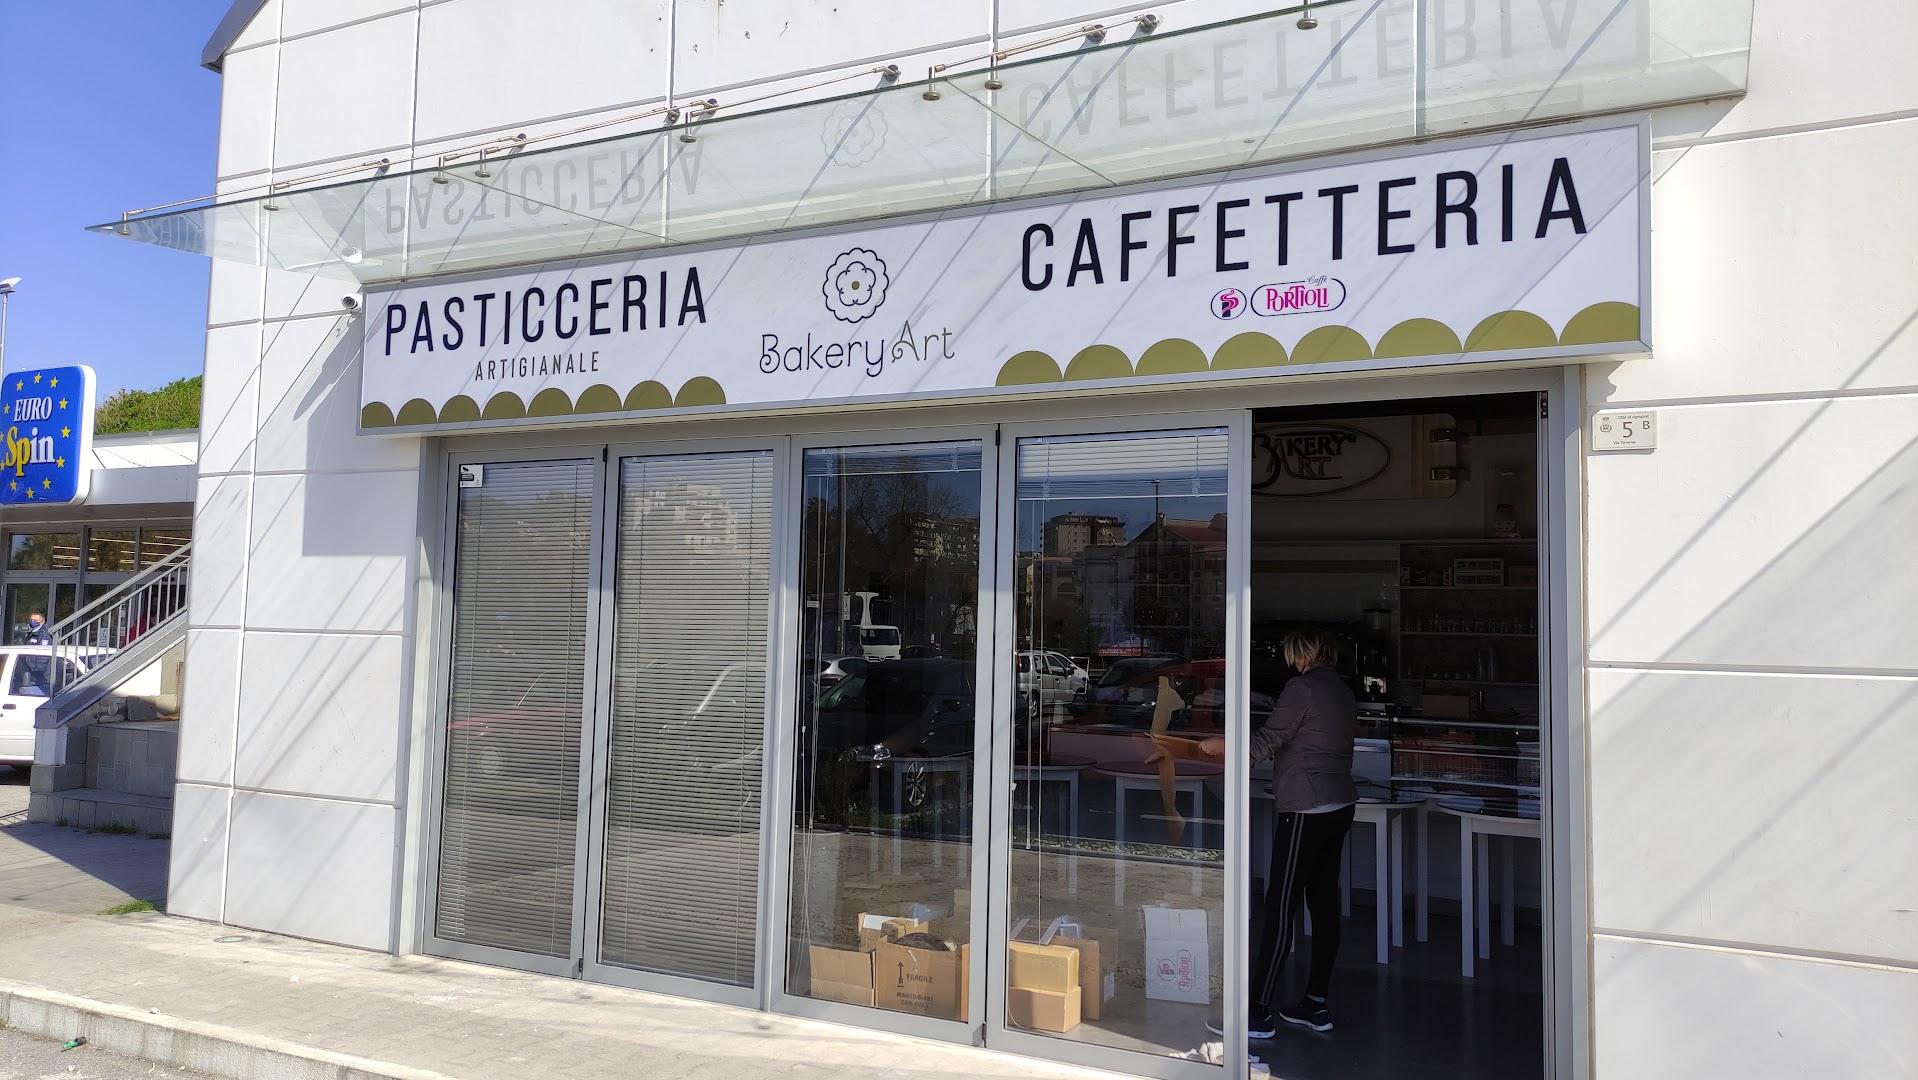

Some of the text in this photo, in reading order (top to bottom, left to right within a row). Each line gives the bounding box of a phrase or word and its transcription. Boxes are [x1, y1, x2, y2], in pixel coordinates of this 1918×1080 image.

[1021, 156, 1588, 292] CAFFETTERIA
[384, 266, 707, 357] PASTICCERIA
[474, 350, 600, 382] ARTIGIANALE
[13, 396, 53, 422] EURO
[1622, 420, 1651, 438] 5 B
[5, 426, 56, 477] Spin
[906, 973, 934, 984] FRAGILE
